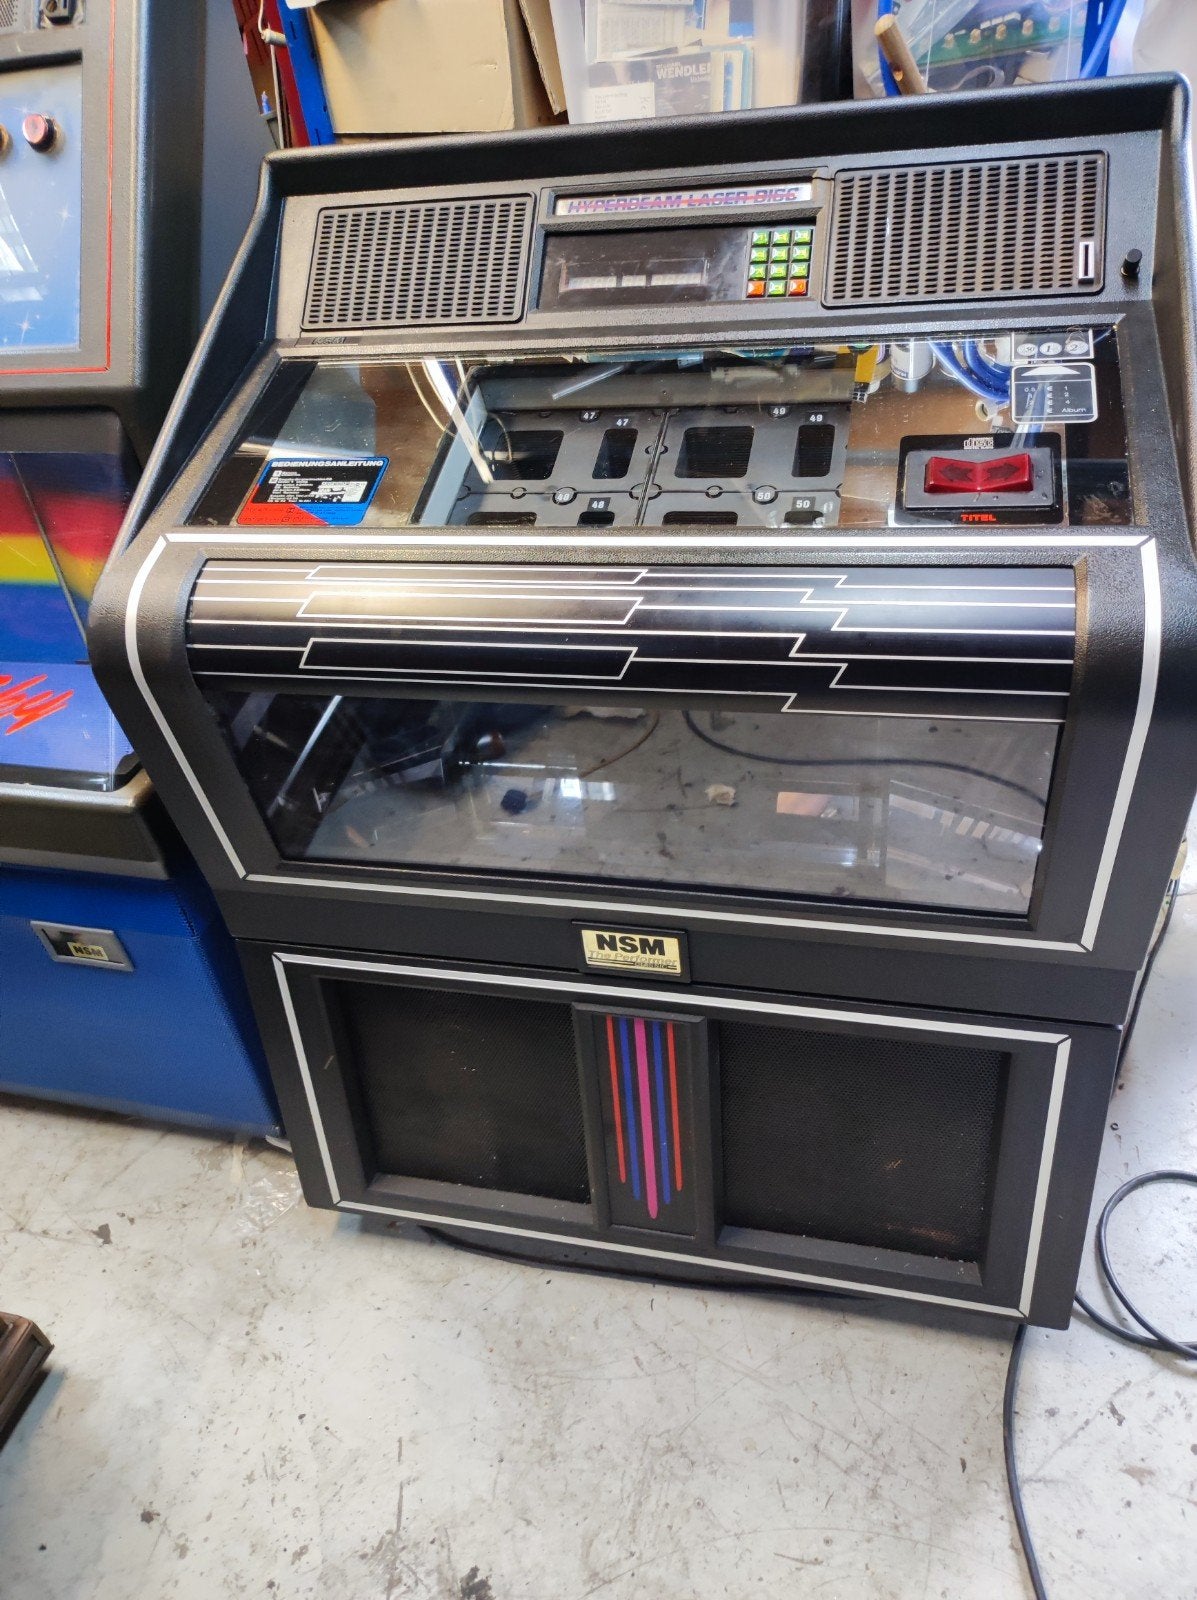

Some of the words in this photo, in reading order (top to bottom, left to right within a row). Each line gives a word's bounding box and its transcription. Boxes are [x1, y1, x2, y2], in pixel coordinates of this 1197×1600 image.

[567, 194, 682, 213] HYPERBEAM
[686, 191, 748, 207] LASER
[753, 187, 799, 204] DISC
[772, 407, 786, 415] 49
[615, 418, 630, 427] 47
[809, 414, 824, 422] 49
[757, 492, 771, 500] 50
[796, 499, 811, 509] 50
[960, 513, 997, 522] TITEL
[596, 933, 666, 956] NSM
[72, 945, 104, 957] NSM
[588, 950, 611, 959] The
[615, 952, 678, 966] Performer
